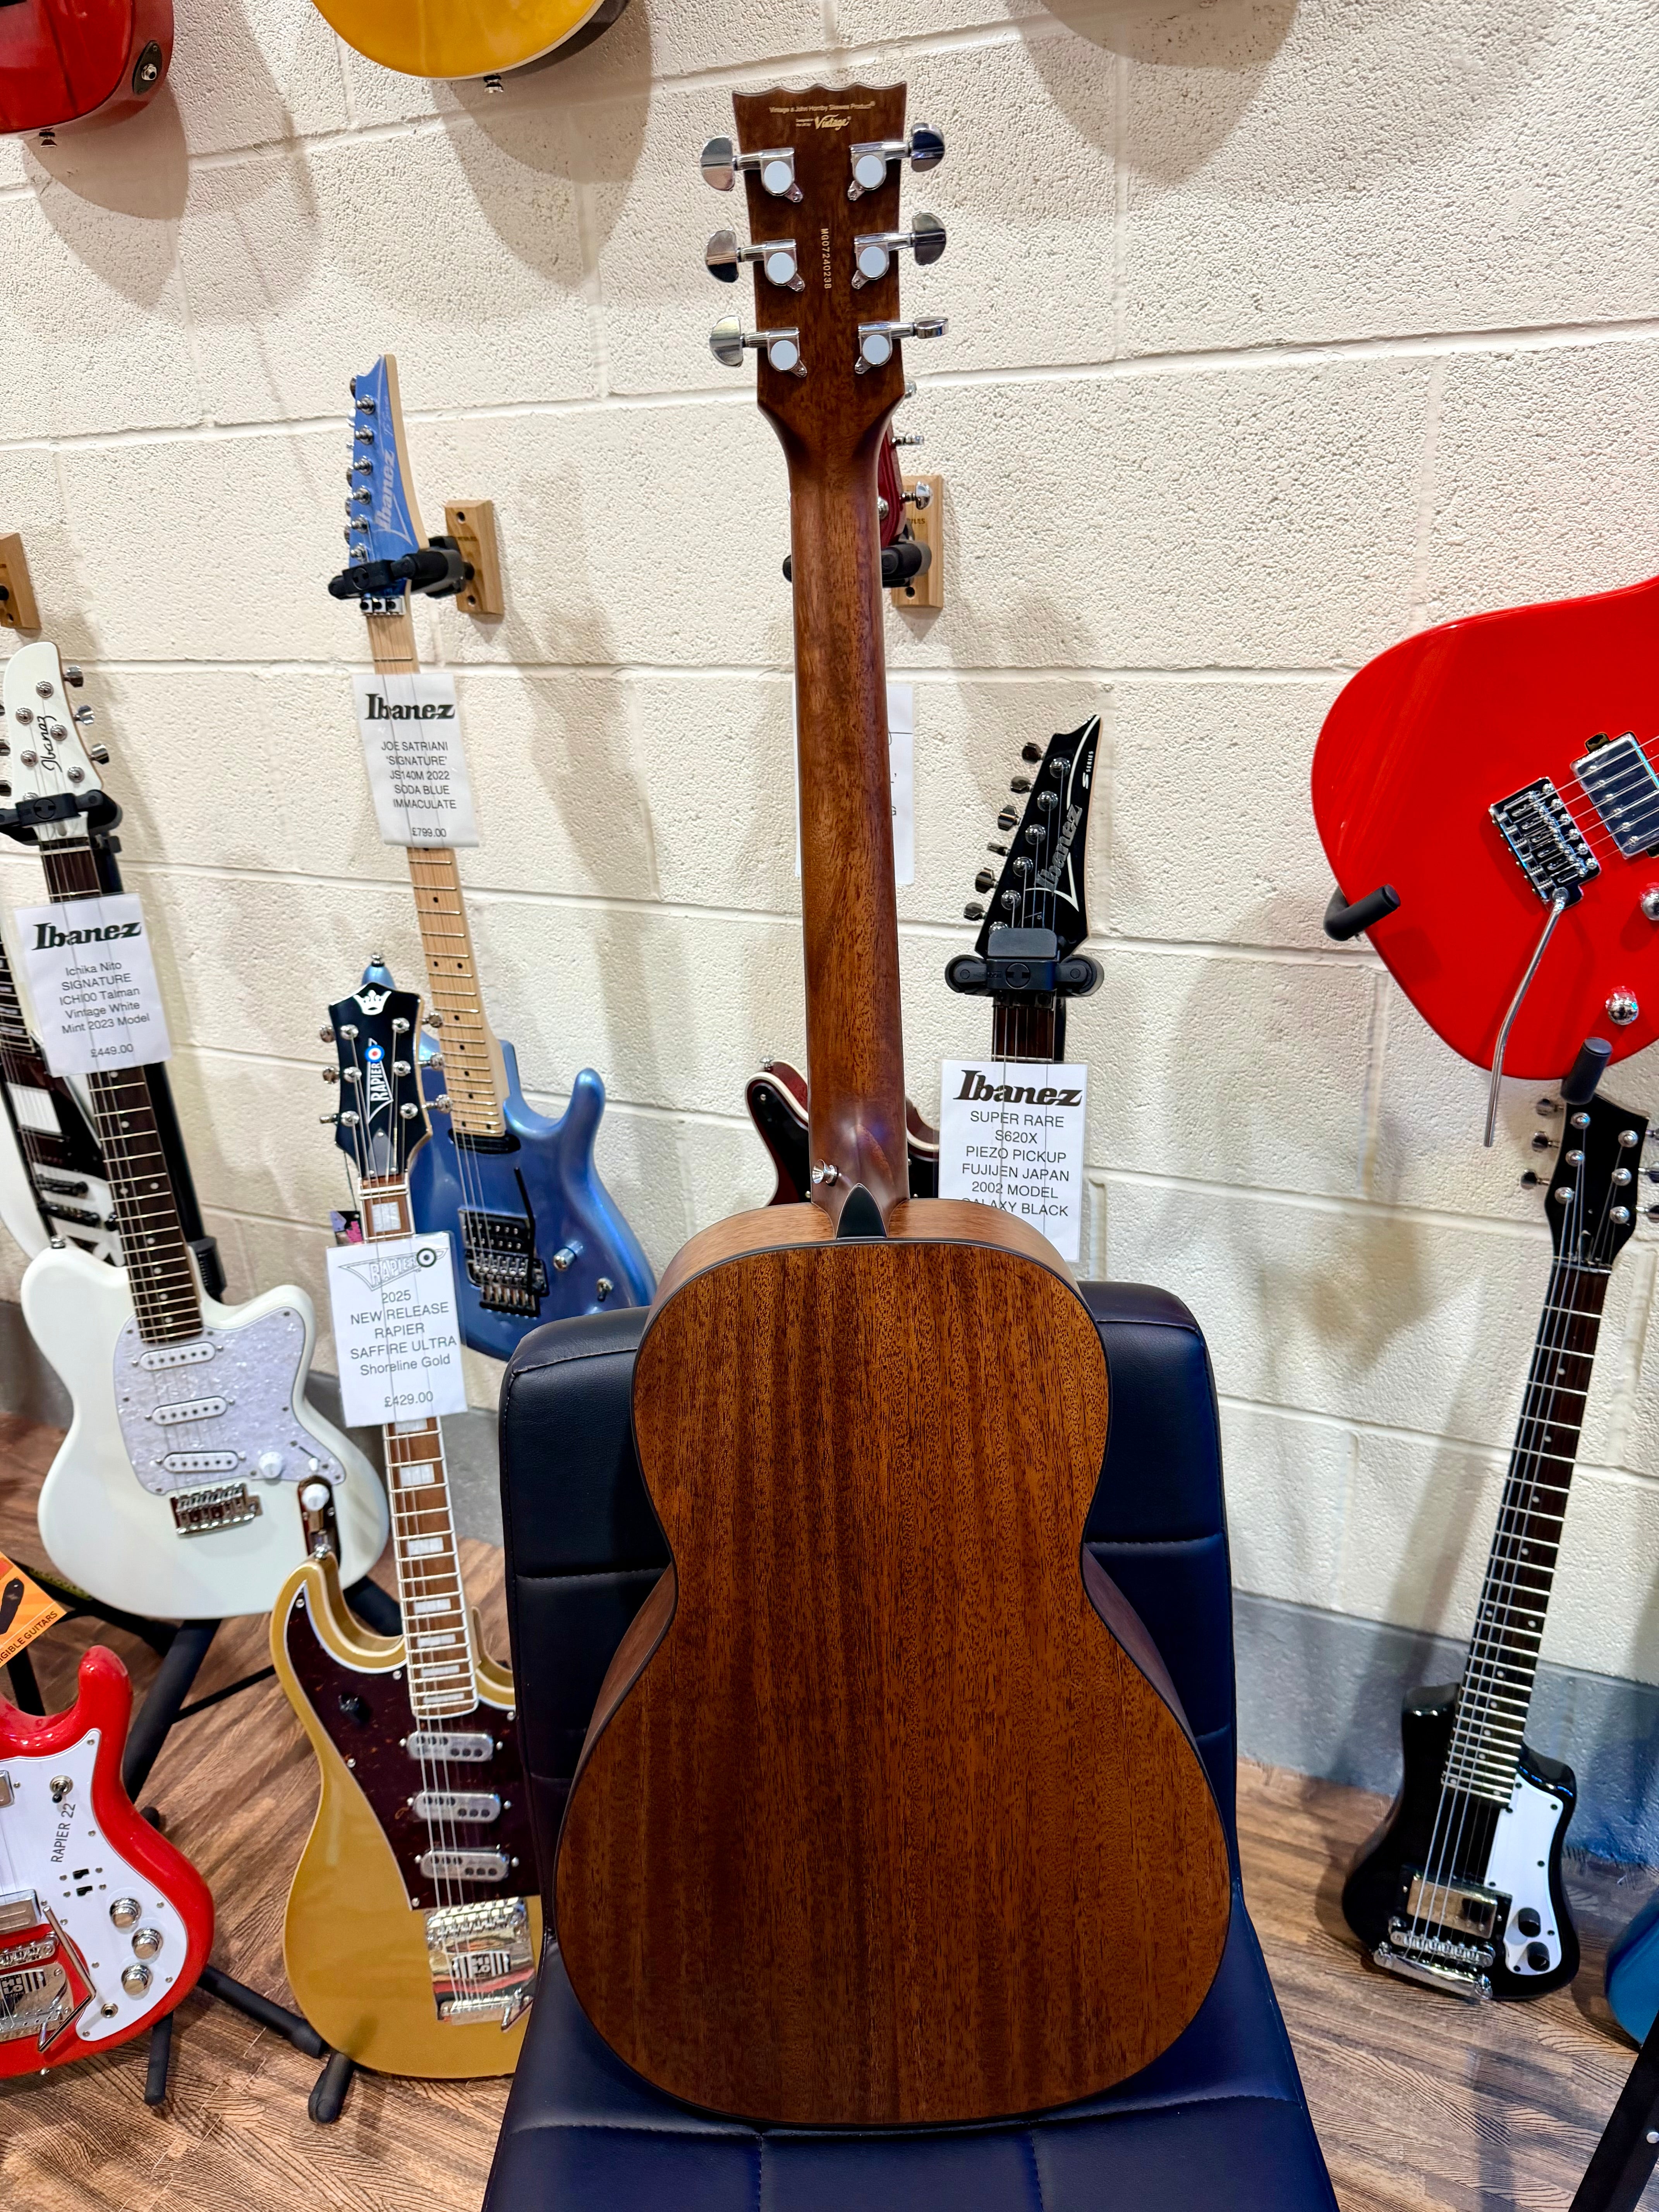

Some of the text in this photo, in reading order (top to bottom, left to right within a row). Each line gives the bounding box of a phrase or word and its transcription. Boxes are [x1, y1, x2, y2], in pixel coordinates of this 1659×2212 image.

[814, 114, 849, 131] Vintage
[374, 450, 395, 533] Ibanez
[364, 694, 455, 720] Ibanez
[381, 742, 448, 751] JOE SATRIANI
[1086, 751, 1094, 772] SERIES
[390, 771, 450, 780] JS140M 2022
[395, 785, 450, 795] SODA BLUE
[393, 800, 457, 809] IMMACULATE
[412, 828, 447, 837] £799.00
[1034, 804, 1083, 896] Ibanez
[32, 922, 142, 950] Ibanez
[65, 962, 122, 976] Ichika Nito
[62, 973, 132, 991] SIGNATURE
[100, 988, 140, 1001] Talman
[65, 1001, 140, 1019] Vintage White
[62, 1013, 150, 1034] Mint 2023 Model
[91, 1043, 134, 1058] £449.00
[371, 1062, 390, 1102] RAPIER
[953, 1070, 1083, 1107] Ibanez
[970, 1111, 1065, 1128] SUPER RARE
[995, 1130, 1038, 1144] S620X
[966, 1146, 1066, 1163] PIEZO PICKUP
[962, 1163, 1069, 1182] FUJIJEN JAPAN
[972, 1181, 1058, 1199] 2002 MODEL
[1022, 1203, 1069, 1216] BLACK
[369, 1256, 417, 1286] RAPIER
[382, 1290, 411, 1304] 2025
[350, 1302, 449, 1325] NEW RELEASE
[374, 1322, 425, 1339] RAPIER
[350, 1336, 457, 1360] SAFFIRE ULTRA
[360, 1354, 450, 1376] Shoreline Gold
[384, 1391, 434, 1408] £429.00
[0, 1611, 58, 1663] IGIBLE GUITARS
[51, 1803, 76, 1863] RAPIER 22
[1, 1977, 22, 1987] HI
[3, 1984, 24, 1995] LO
